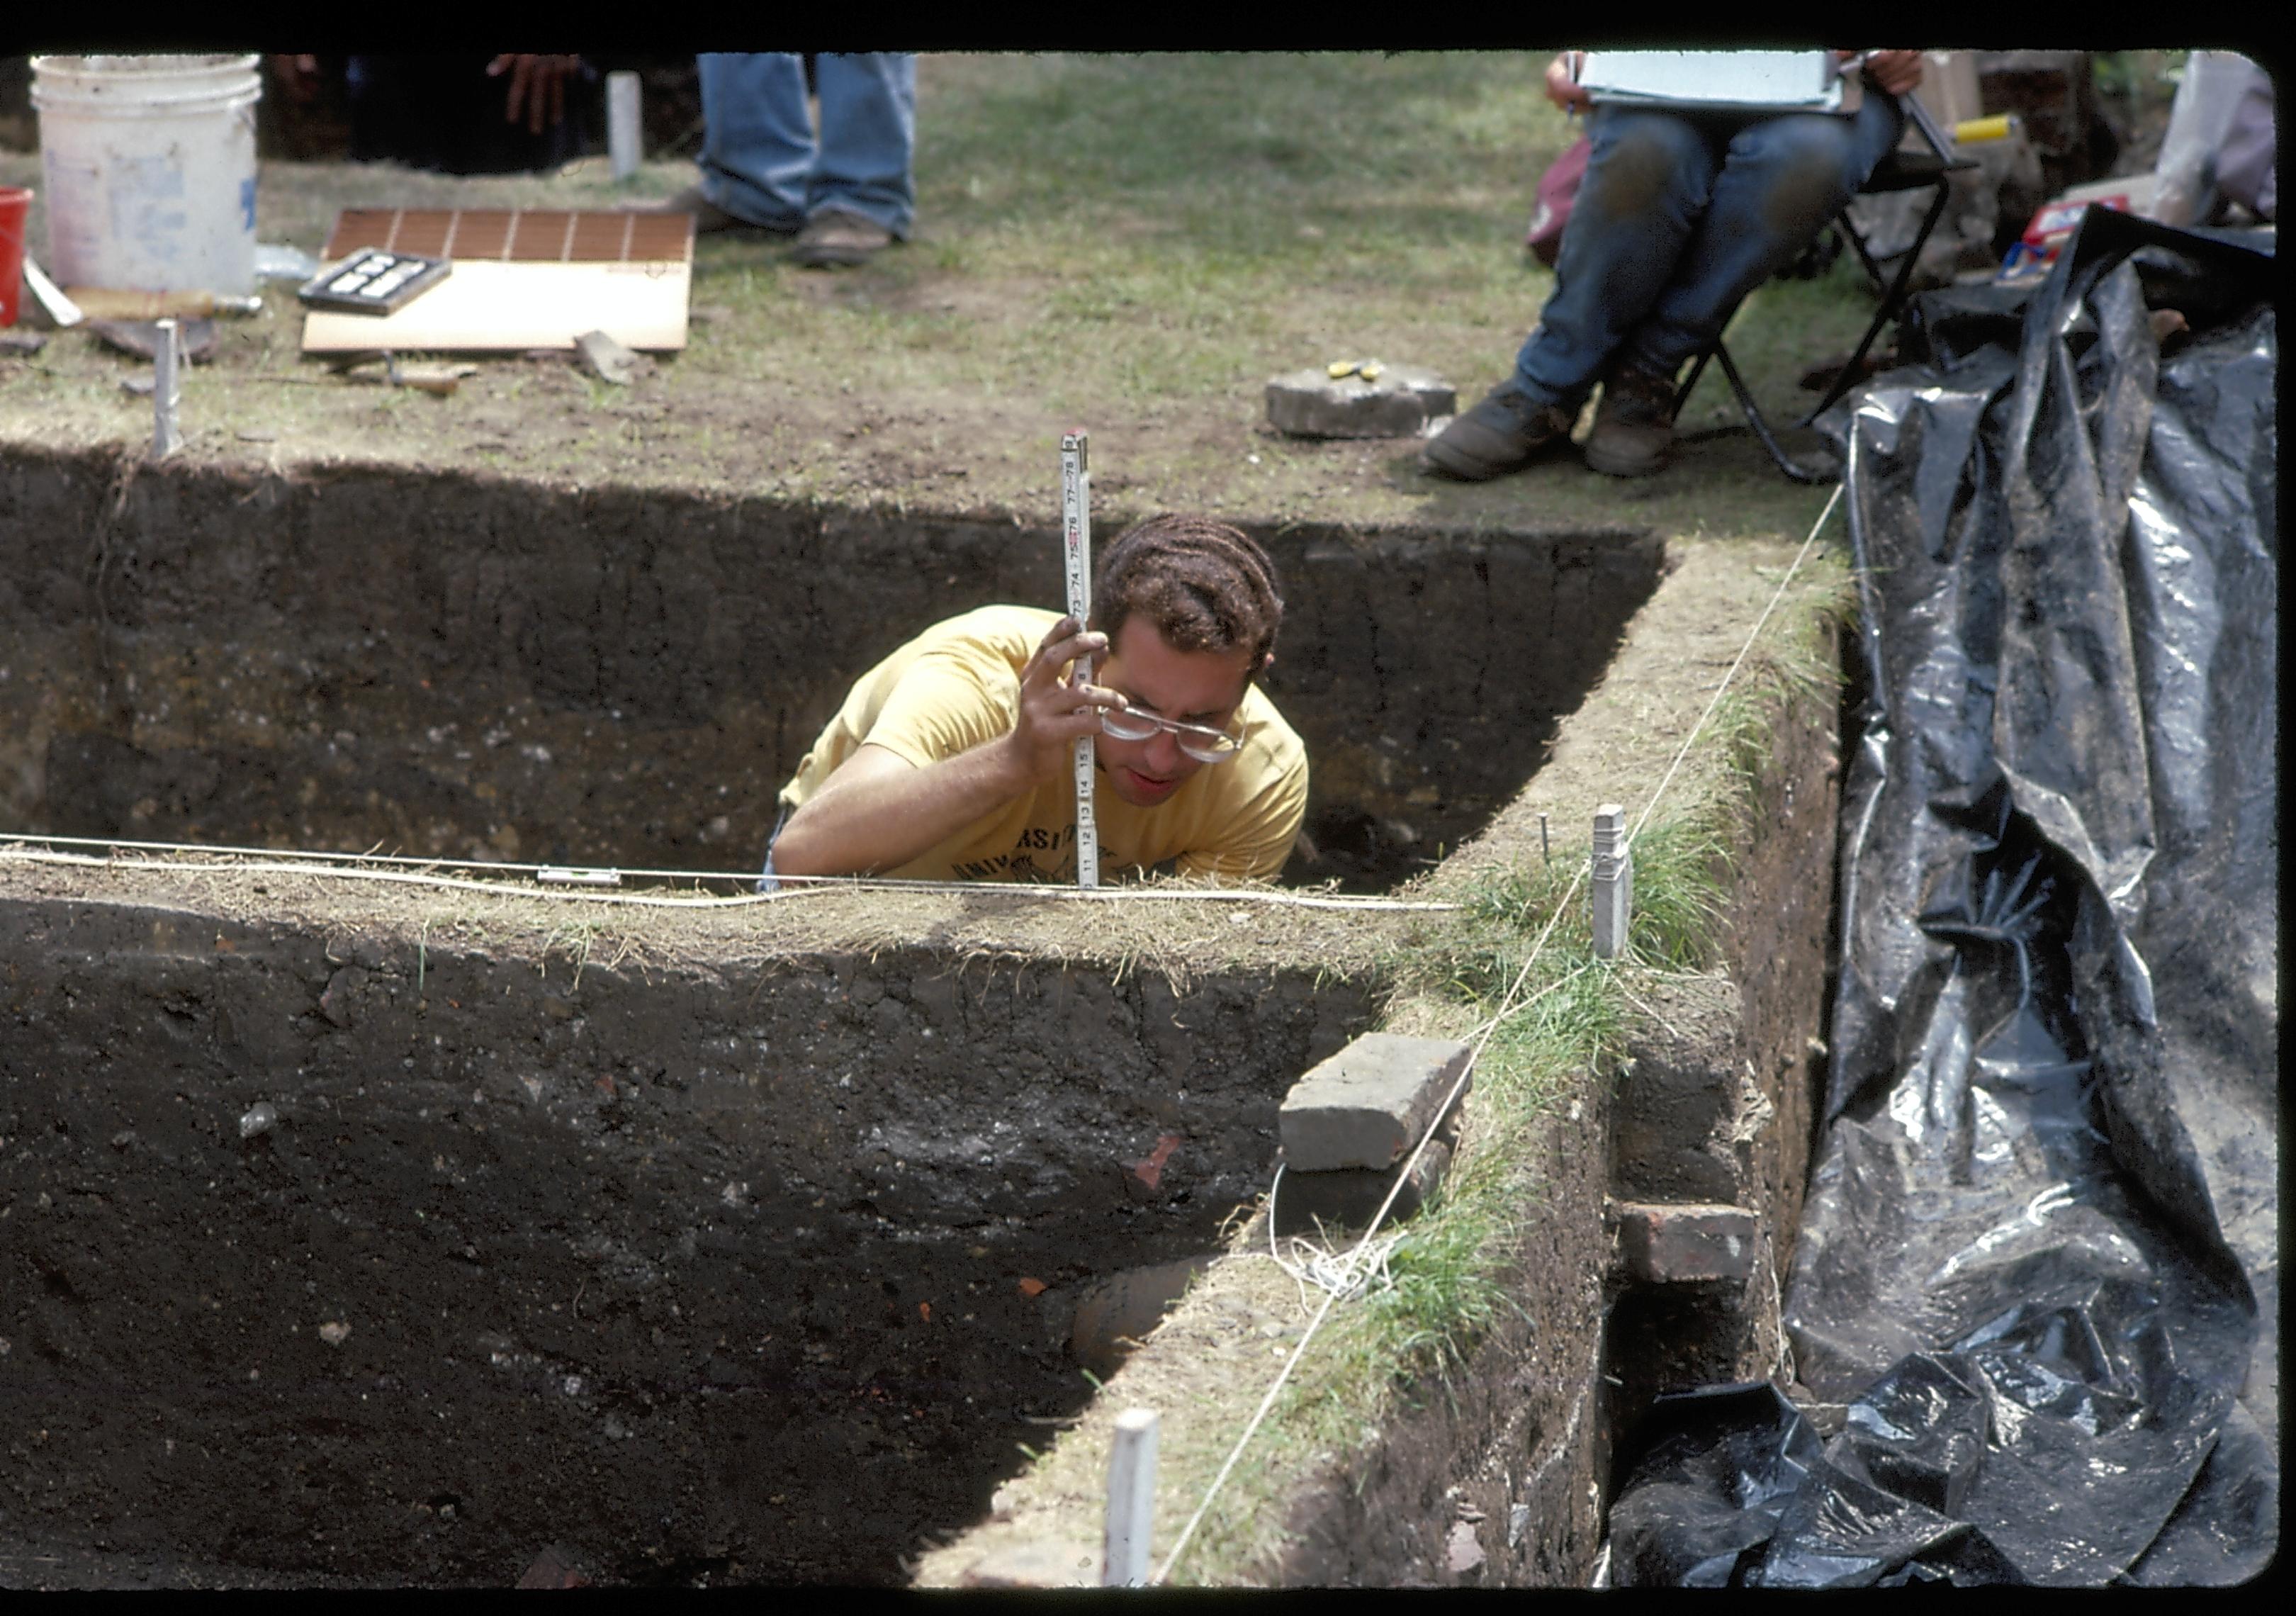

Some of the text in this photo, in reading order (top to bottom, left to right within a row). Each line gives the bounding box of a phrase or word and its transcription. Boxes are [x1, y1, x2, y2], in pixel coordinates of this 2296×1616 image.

[1066, 462, 1074, 476] 78
[1067, 490, 1076, 504] 77
[1069, 517, 1077, 533] 76
[1071, 544, 1079, 559] 75
[1072, 573, 1080, 588] 74
[1080, 754, 1088, 767] 15
[1081, 781, 1088, 794] 14
[1081, 807, 1089, 819] 13
[1083, 832, 1091, 845] 12
[1084, 860, 1091, 871] 11
